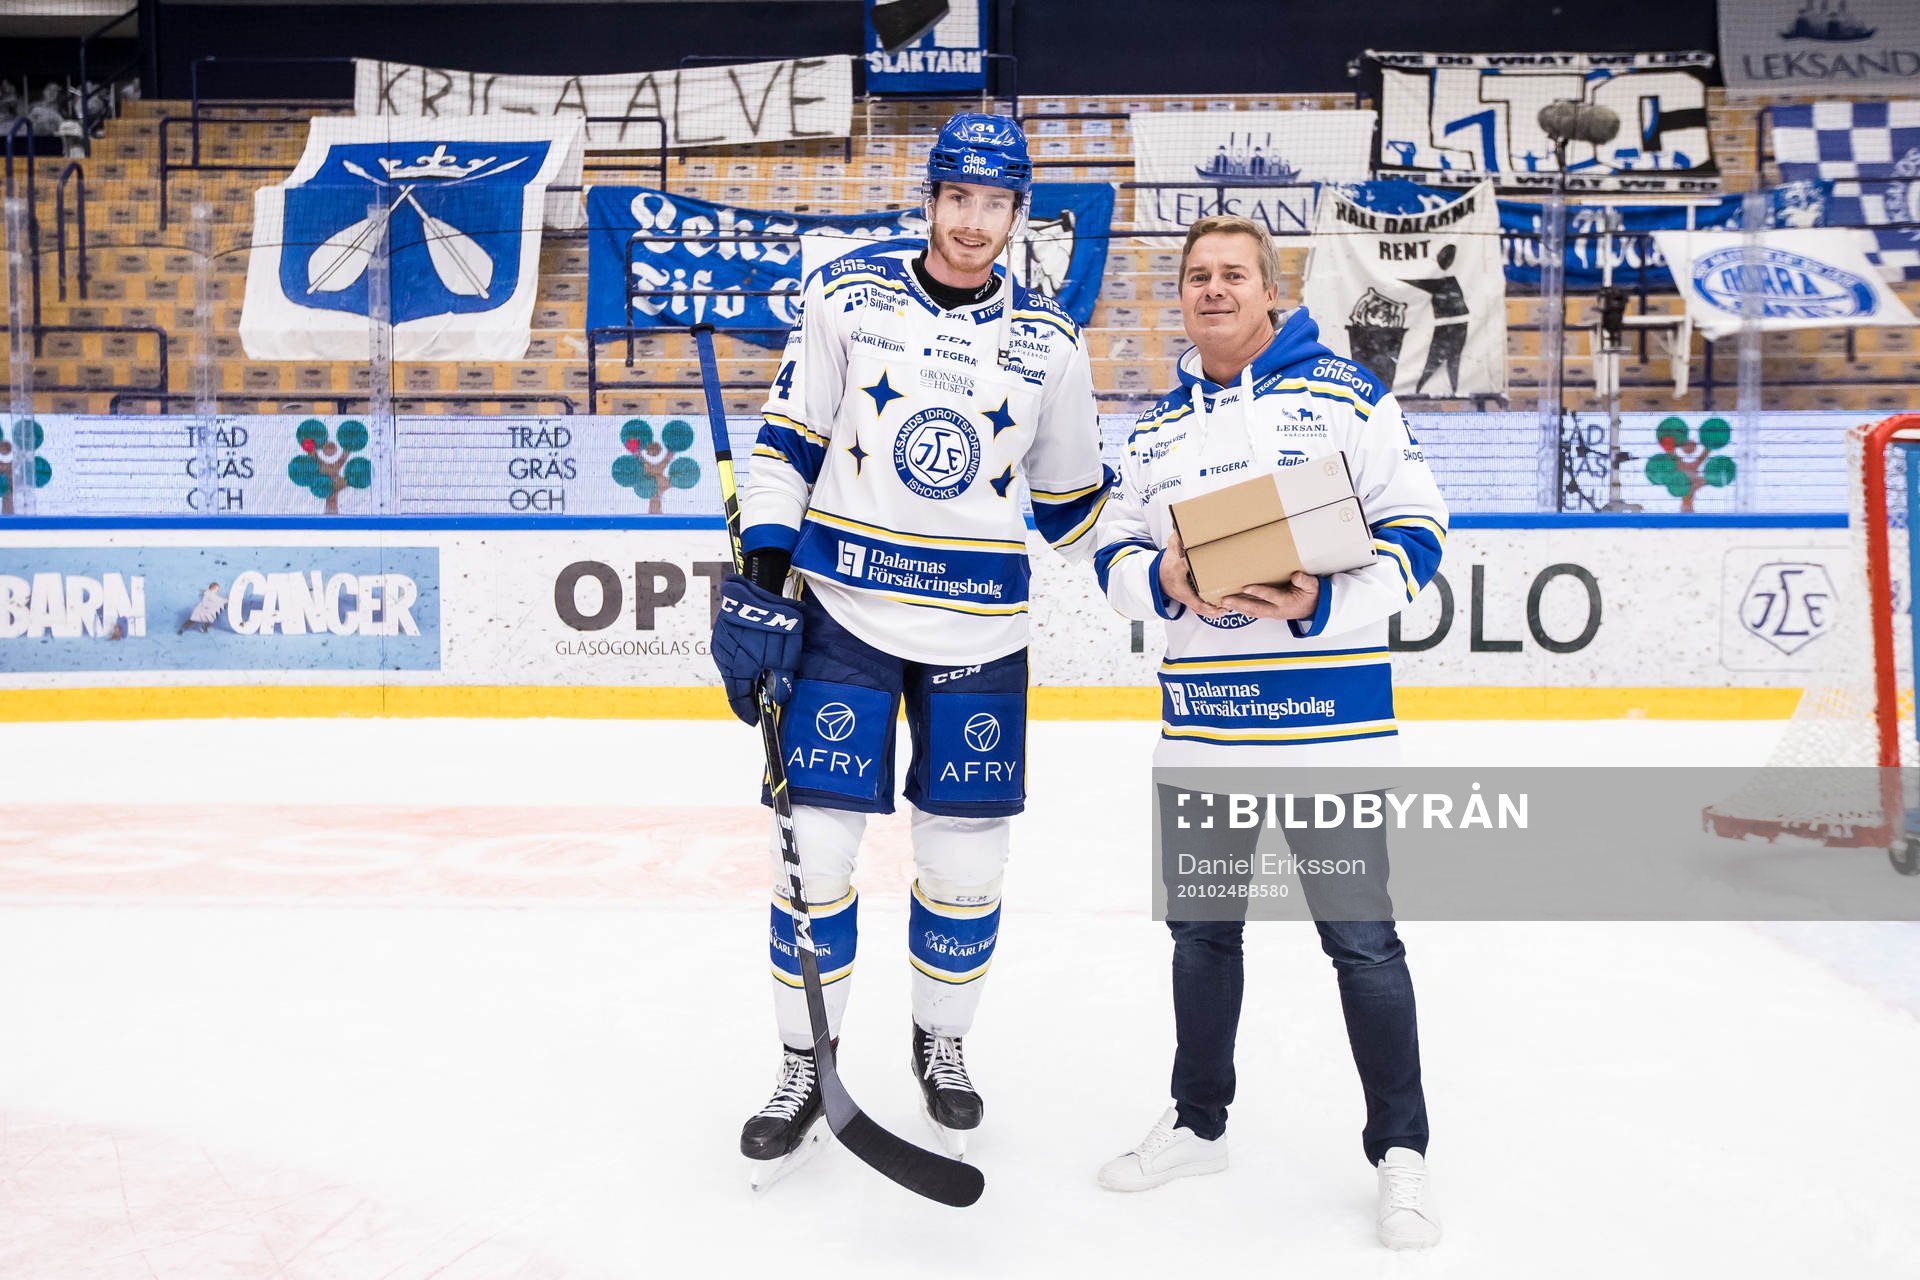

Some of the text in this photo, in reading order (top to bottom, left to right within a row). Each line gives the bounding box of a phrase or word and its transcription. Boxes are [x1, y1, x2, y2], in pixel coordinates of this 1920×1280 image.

[1437, 55, 1472, 66] DO
[1487, 54, 1575, 66] WHAT
[1742, 50, 1920, 80] LEKSAND
[963, 153, 987, 165] clas
[962, 163, 999, 178] ohlson
[1156, 188, 1307, 235] LEKSAN
[1379, 240, 1431, 261] RENT
[831, 264, 887, 277] ohlson
[869, 297, 896, 313] Siljan
[944, 312, 969, 322] SHL
[936, 334, 972, 347] CCM
[935, 349, 978, 368] TEGERA
[1318, 358, 1358, 372] clas
[776, 360, 797, 400] 4
[933, 379, 968, 396] HUSET
[1254, 374, 1283, 395] TEGERA
[1312, 366, 1373, 398] ohlson
[1220, 394, 1240, 407] SHL
[508, 419, 572, 448] TRÄD
[894, 414, 924, 471] LEKSANDS
[508, 452, 577, 480] GRÄS
[1209, 462, 1248, 475] TEGERA
[906, 478, 960, 499] ISHOCKEY
[508, 488, 565, 512] OCH
[870, 549, 946, 575] Dalarnas
[0, 570, 421, 639] BARN CANCER
[721, 595, 799, 632] CCM
[555, 639, 690, 656] GLASÖGONGLAS
[932, 664, 982, 685] CCM
[1185, 683, 1260, 699] Dalarnas
[1190, 696, 1336, 720] Försäkringsbolag
[787, 746, 872, 778] AFRY
[939, 760, 1017, 783] AFRY
[949, 946, 977, 957] KARL
